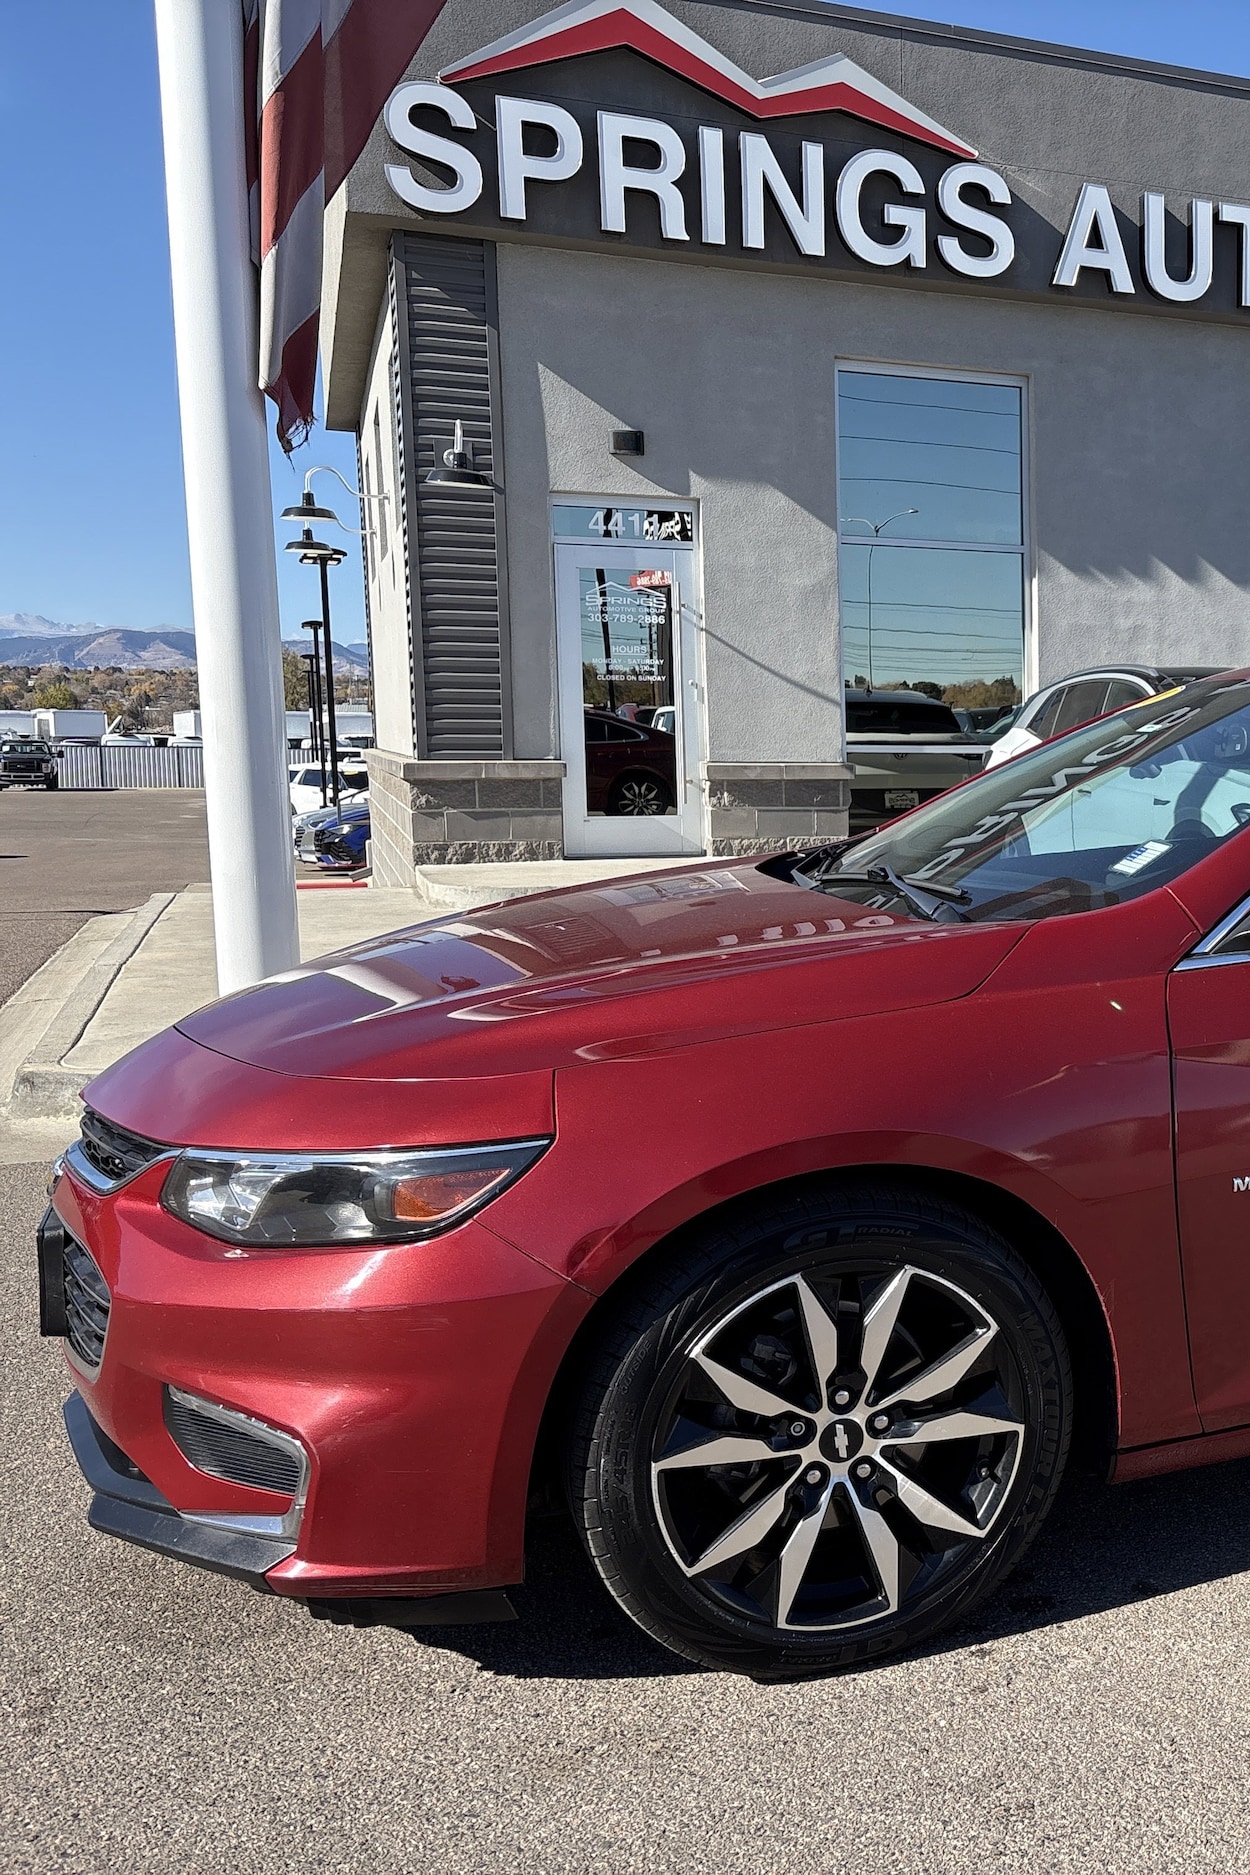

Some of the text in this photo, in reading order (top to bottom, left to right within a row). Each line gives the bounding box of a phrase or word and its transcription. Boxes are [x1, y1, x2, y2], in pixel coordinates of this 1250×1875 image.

[383, 81, 1016, 278] SPRINGS
[588, 511, 659, 540] 4411
[585, 594, 667, 609] SPRINGS
[587, 613, 666, 625] 303-789-2886
[612, 645, 647, 653] HOURS
[857, 1226, 914, 1238] RADIAL
